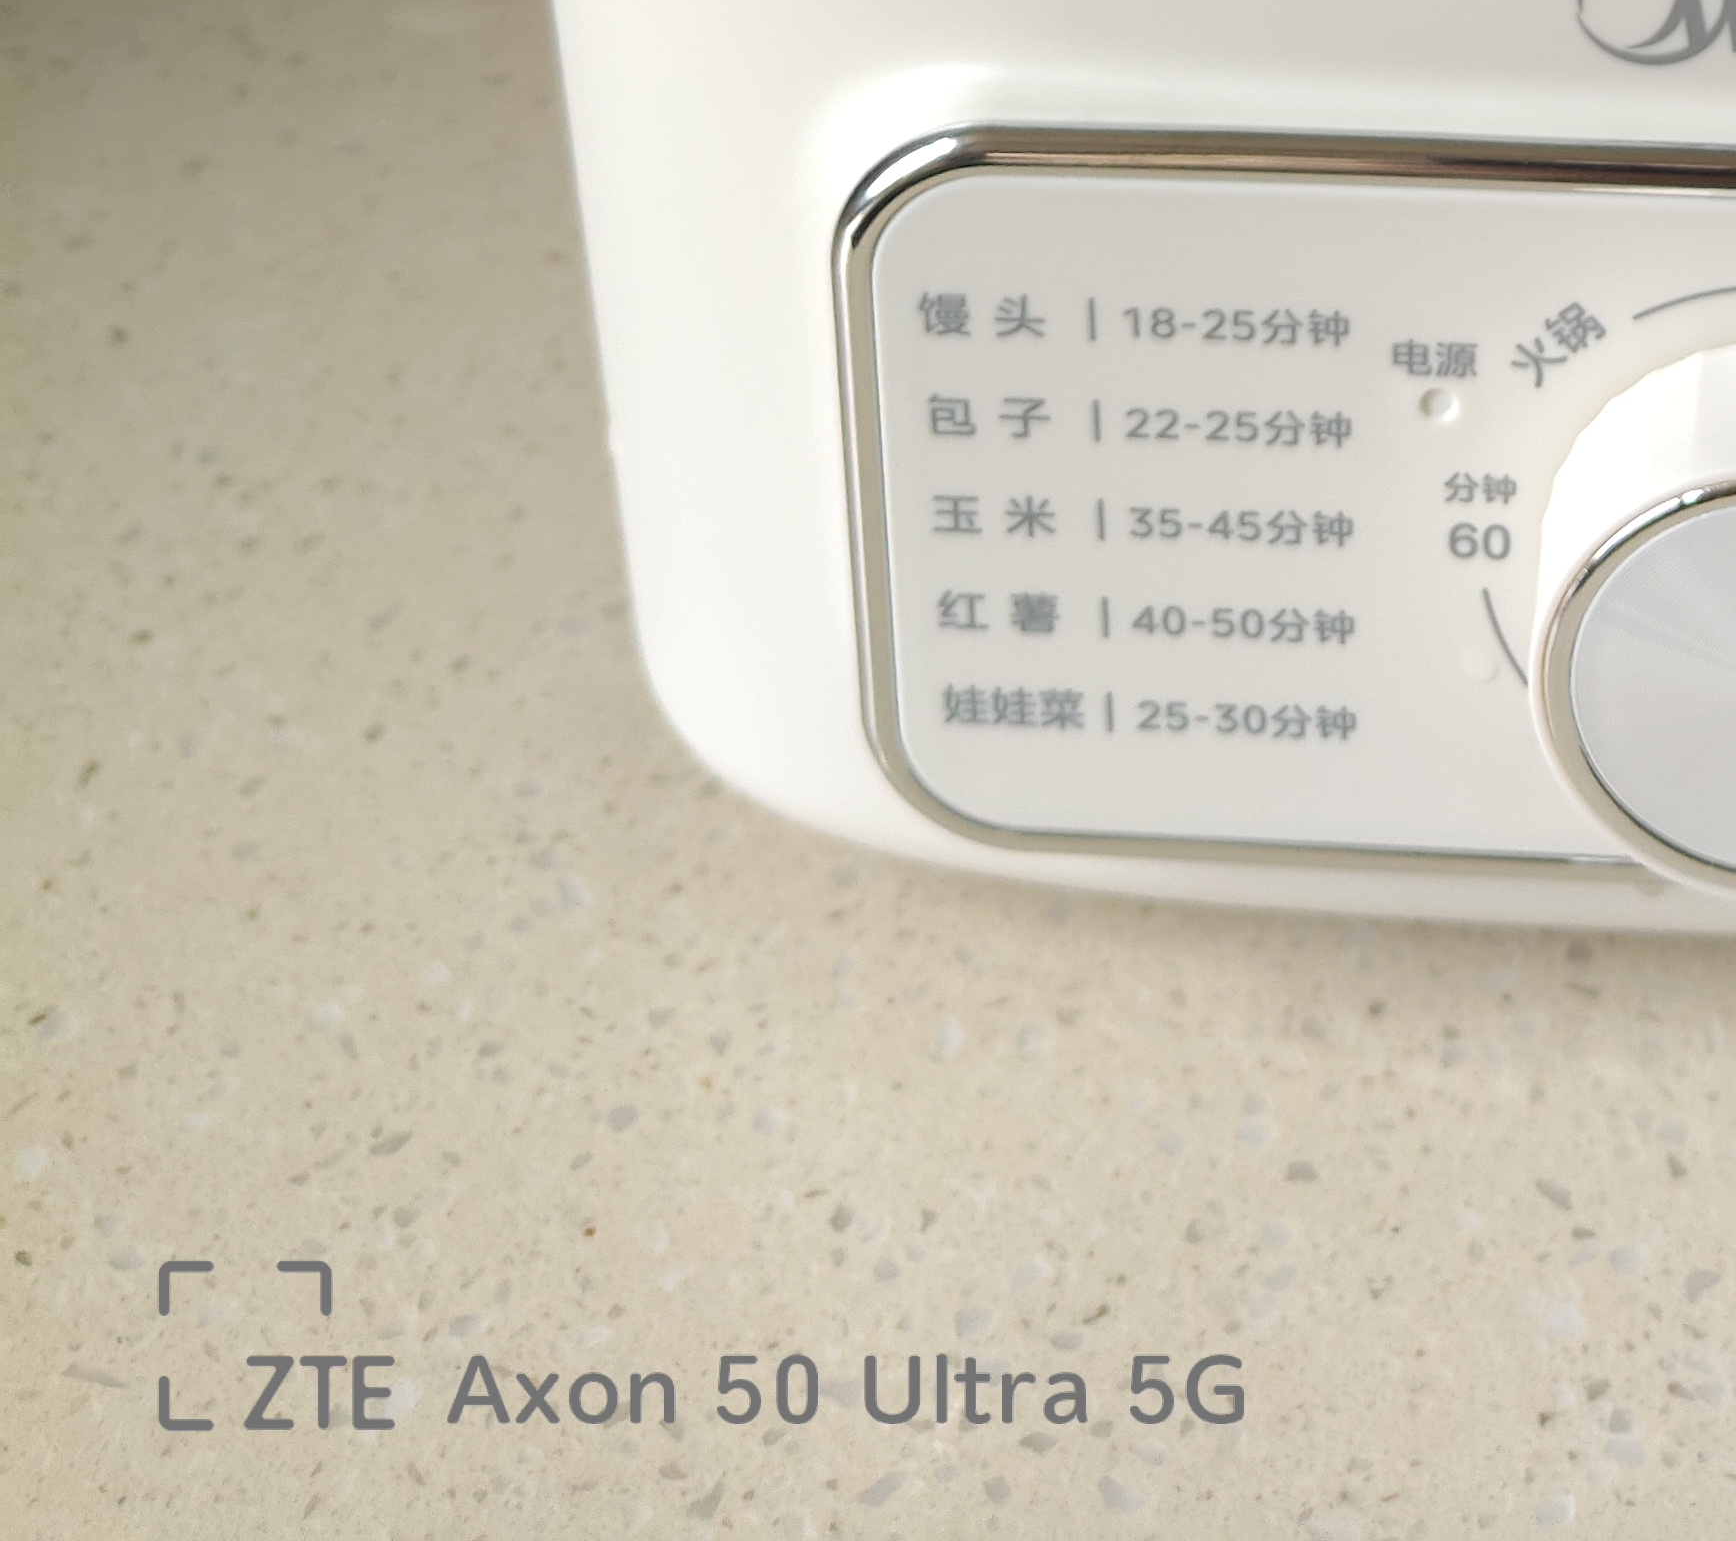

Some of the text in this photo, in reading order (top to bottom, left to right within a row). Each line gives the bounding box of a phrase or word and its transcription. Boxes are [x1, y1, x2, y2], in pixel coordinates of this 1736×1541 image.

[1124, 308, 1350, 347] 18-25分钟
[1511, 302, 1606, 388] 火锅
[1392, 339, 1477, 378] 电源
[1126, 408, 1352, 448] 22-25分钟
[1444, 472, 1517, 504] 分钟
[1130, 507, 1354, 547] 35-45分钟
[1448, 523, 1510, 560] 60
[1132, 606, 1355, 645] 40-50分钟
[1138, 700, 1357, 741] 25-30分钟
